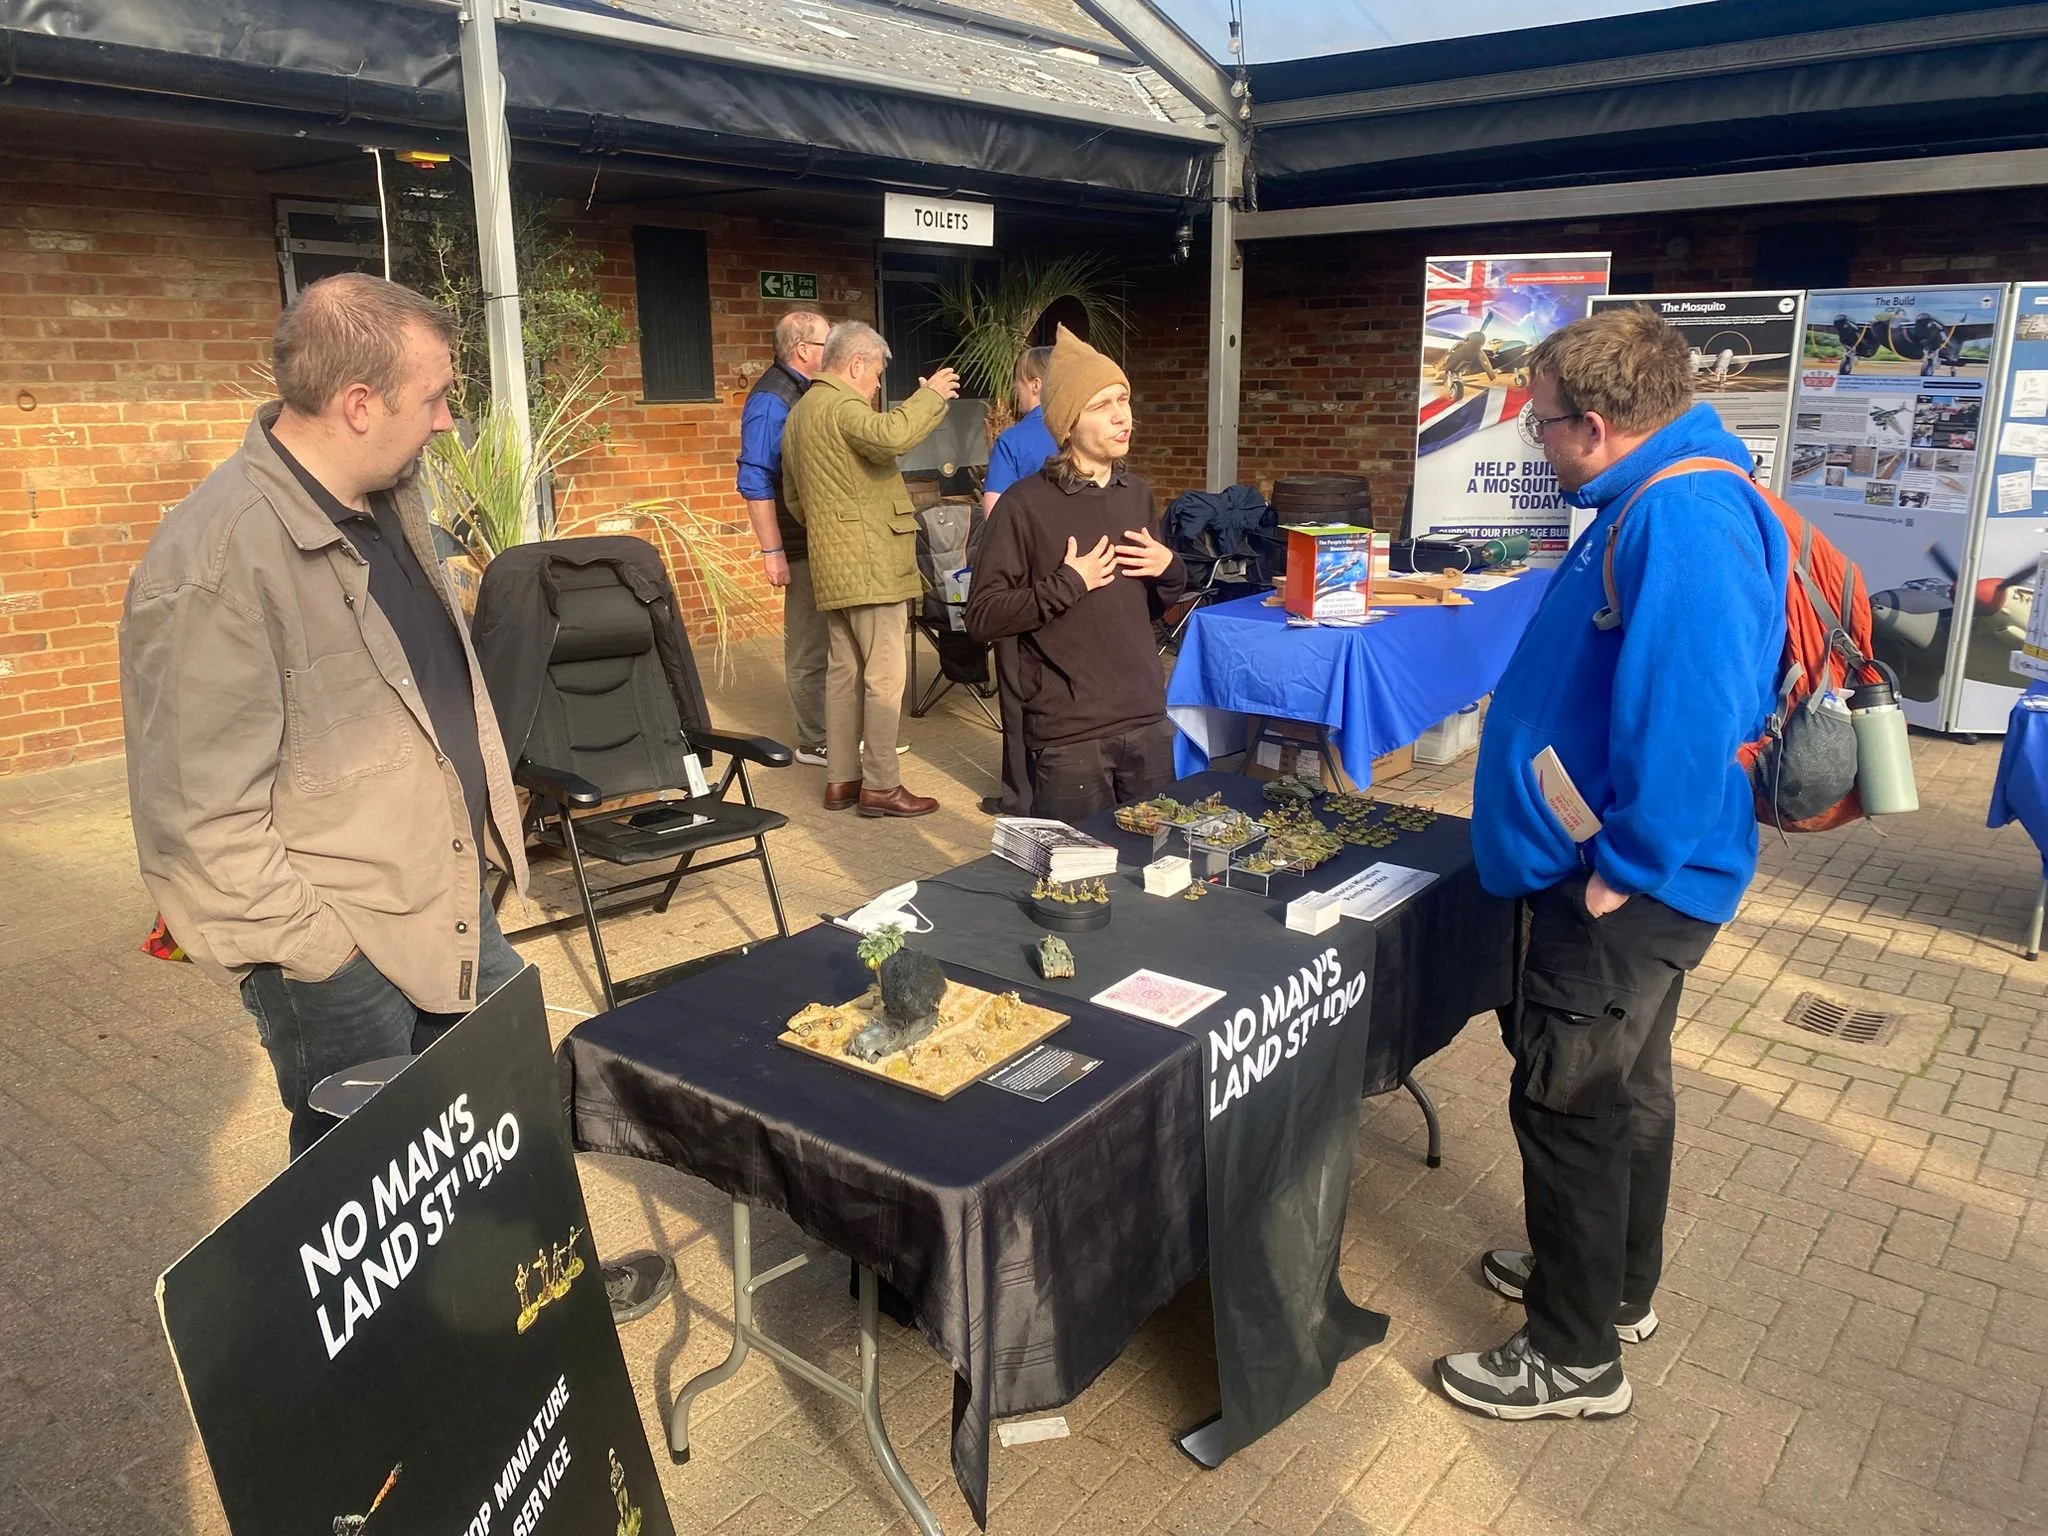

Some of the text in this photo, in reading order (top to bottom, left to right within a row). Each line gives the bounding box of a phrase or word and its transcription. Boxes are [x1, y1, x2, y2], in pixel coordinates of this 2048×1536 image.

[915, 208, 969, 230] TOILETS
[798, 276, 814, 287] Fire
[799, 288, 814, 298] exit
[1875, 296, 1915, 306] The Build
[1661, 302, 1726, 314] The Mosquito
[1474, 461, 1558, 477] HELP BUIL
[1466, 478, 1563, 495] A MOSQUIT
[1509, 494, 1567, 509] TODAY!
[1481, 528, 1500, 538] OUR
[1502, 528, 1548, 538] FUSEAGE
[1550, 528, 1569, 538] BUIL
[1208, 947, 1342, 1073] NO MAN'S
[1210, 1035, 1282, 1121] LAND
[299, 1093, 475, 1299] NO MAN'S
[316, 1221, 419, 1360] LAND
[463, 1373, 571, 1536] OP MINIATURE
[512, 1436, 572, 1536] SERVICE
